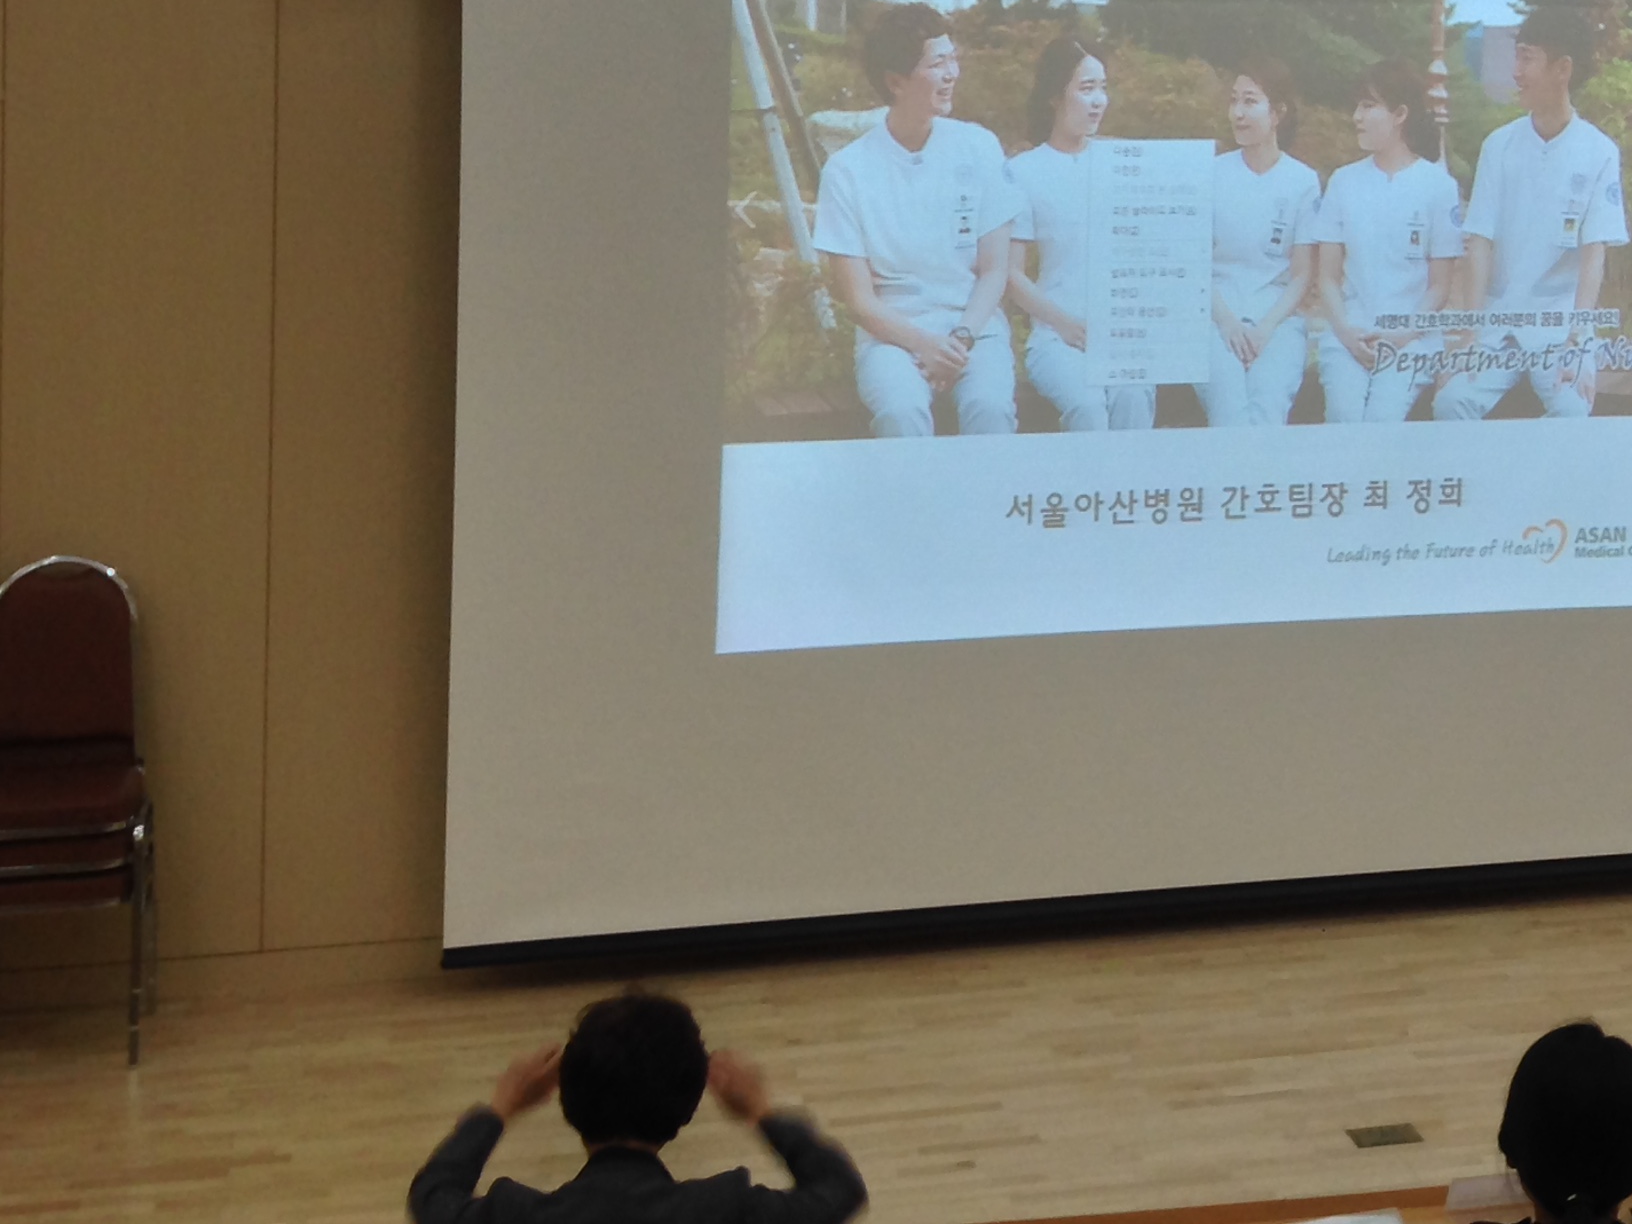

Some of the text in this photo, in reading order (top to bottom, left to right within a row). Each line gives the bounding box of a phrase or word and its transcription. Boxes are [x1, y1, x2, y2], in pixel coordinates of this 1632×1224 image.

[1373, 342, 1554, 392] Department
[1562, 337, 1593, 387] of
[1004, 477, 1464, 529] 서울아산병원 간호팀장 최 정희
[1574, 526, 1627, 544] ASAN
[1326, 537, 1555, 566] Leading the Future of Health
[1574, 545, 1624, 559] Medical
